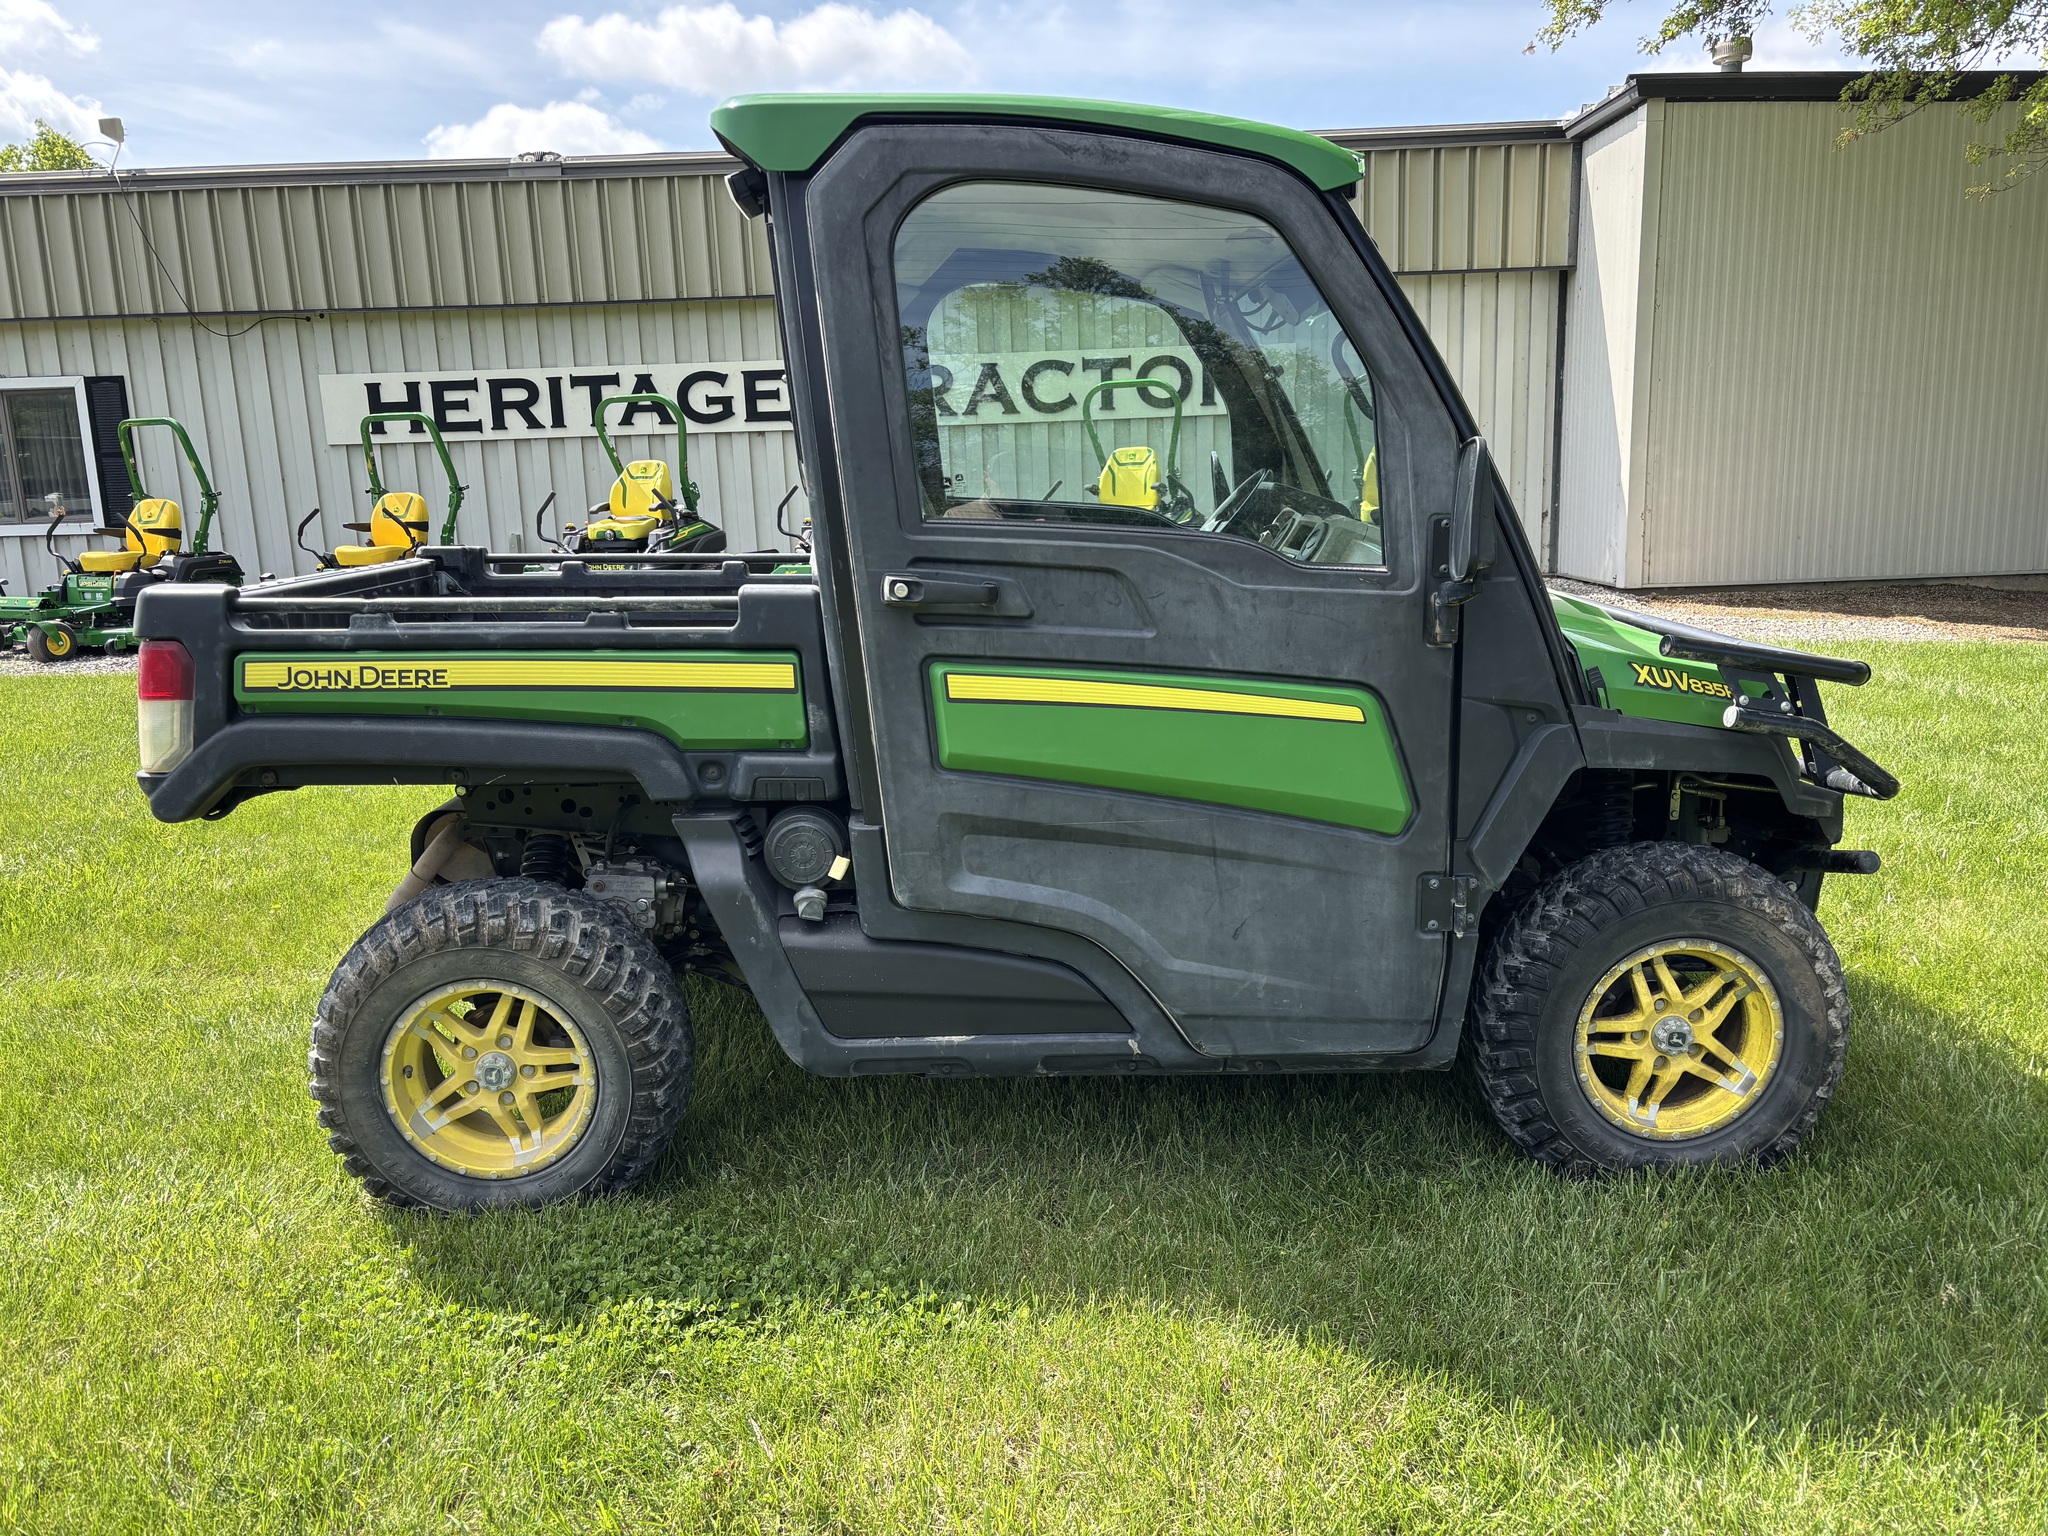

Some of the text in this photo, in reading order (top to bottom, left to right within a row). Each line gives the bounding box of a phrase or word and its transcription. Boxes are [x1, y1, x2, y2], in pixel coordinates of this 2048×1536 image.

[363, 371, 793, 434] HERITAGE
[278, 665, 448, 687] JOHN DEERE
